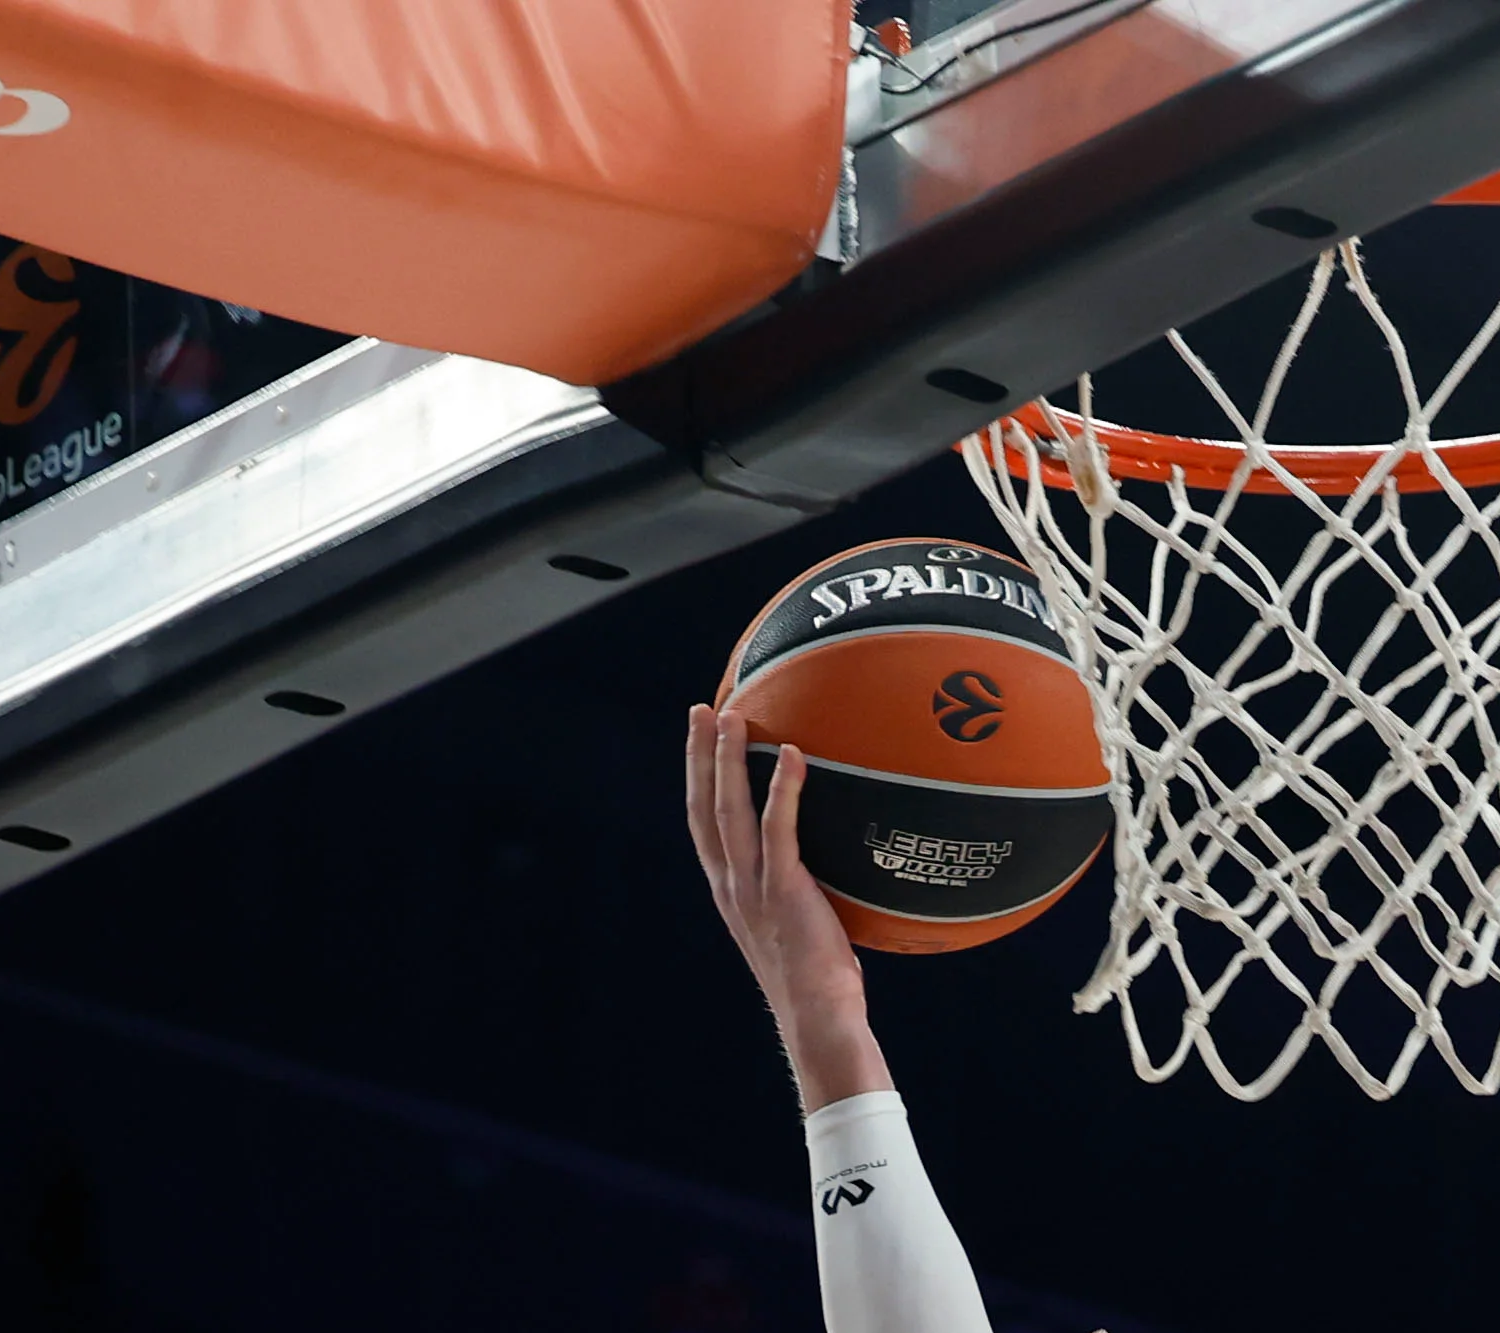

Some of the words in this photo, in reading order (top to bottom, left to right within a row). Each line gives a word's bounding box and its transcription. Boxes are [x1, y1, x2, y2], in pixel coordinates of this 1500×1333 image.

[810, 564, 1056, 631] SPALDIN
[864, 822, 1013, 864] LEGACY
[905, 859, 996, 879] 1000
